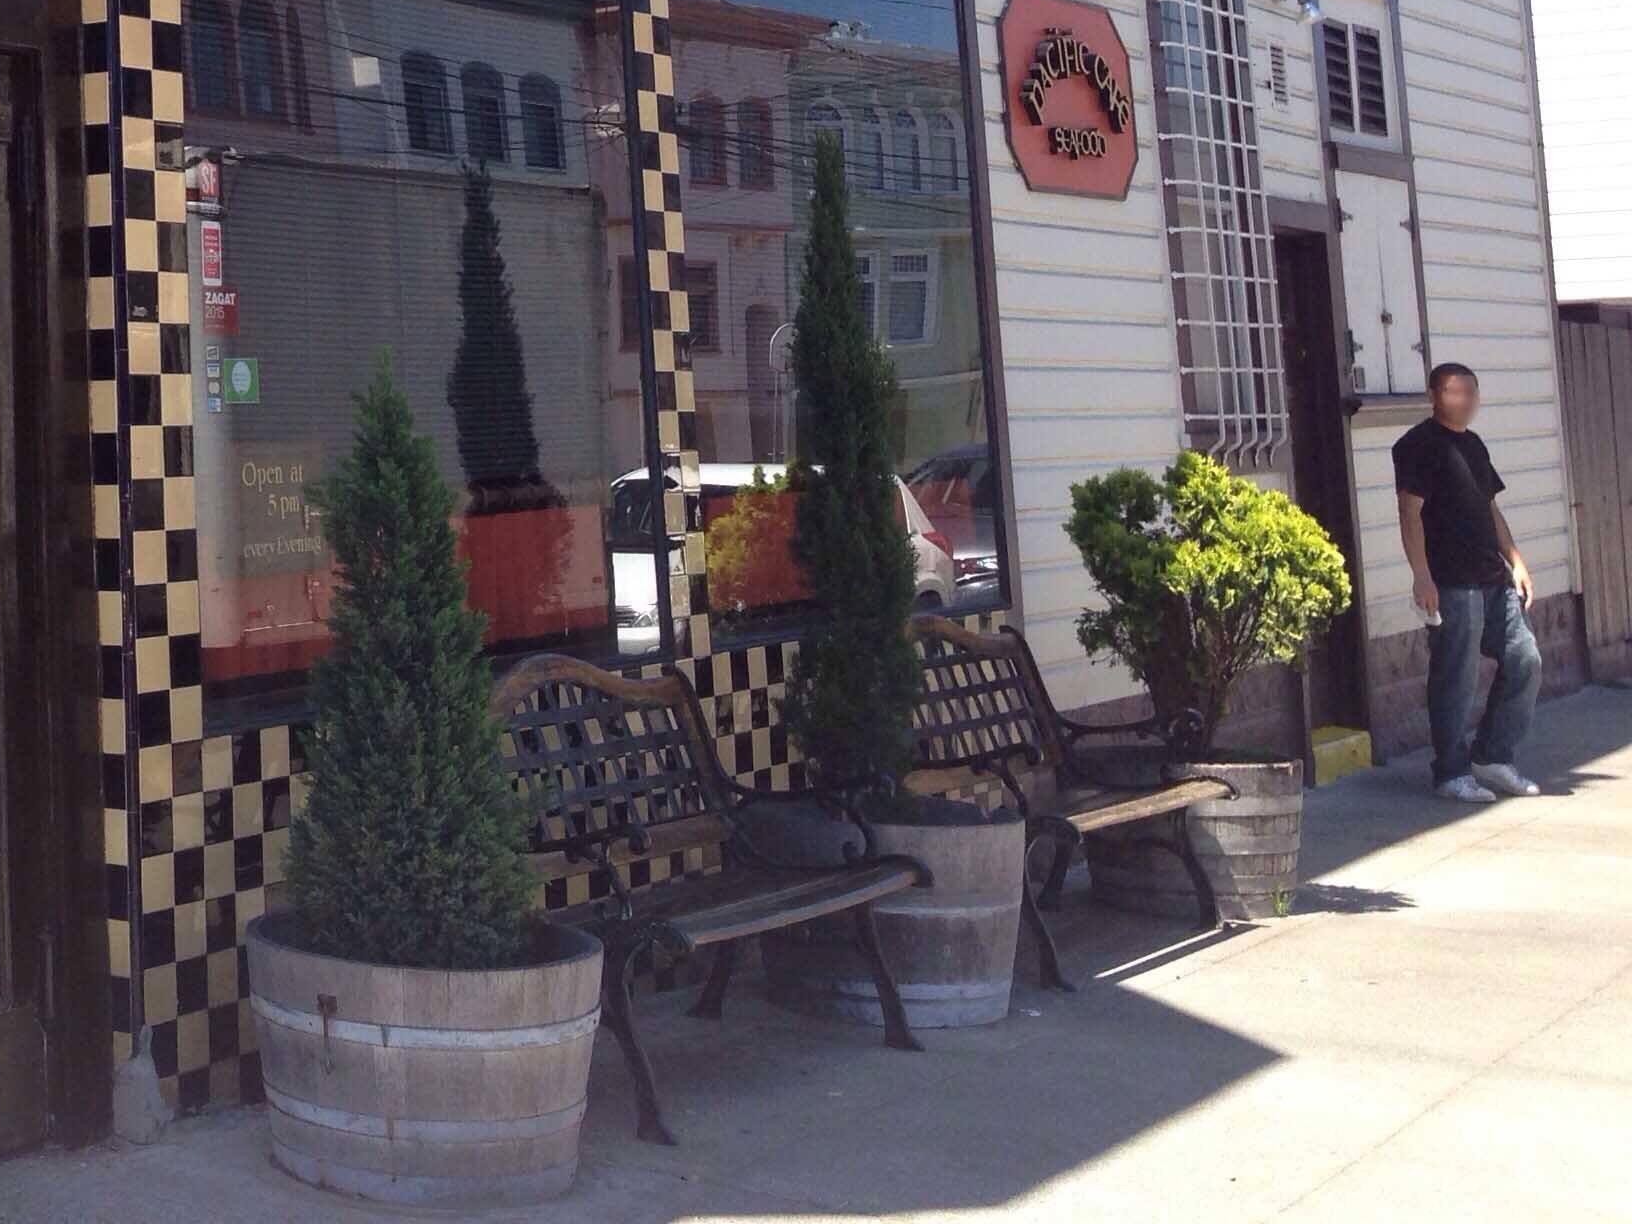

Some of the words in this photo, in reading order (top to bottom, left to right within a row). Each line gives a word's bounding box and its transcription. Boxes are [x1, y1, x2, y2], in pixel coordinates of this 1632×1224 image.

[1025, 34, 1091, 125] PACIFIC
[205, 291, 236, 305] ZAGAT
[242, 462, 284, 492] Open
[290, 464, 303, 482] at
[268, 494, 277, 516] 5
[280, 495, 300, 519] pm
